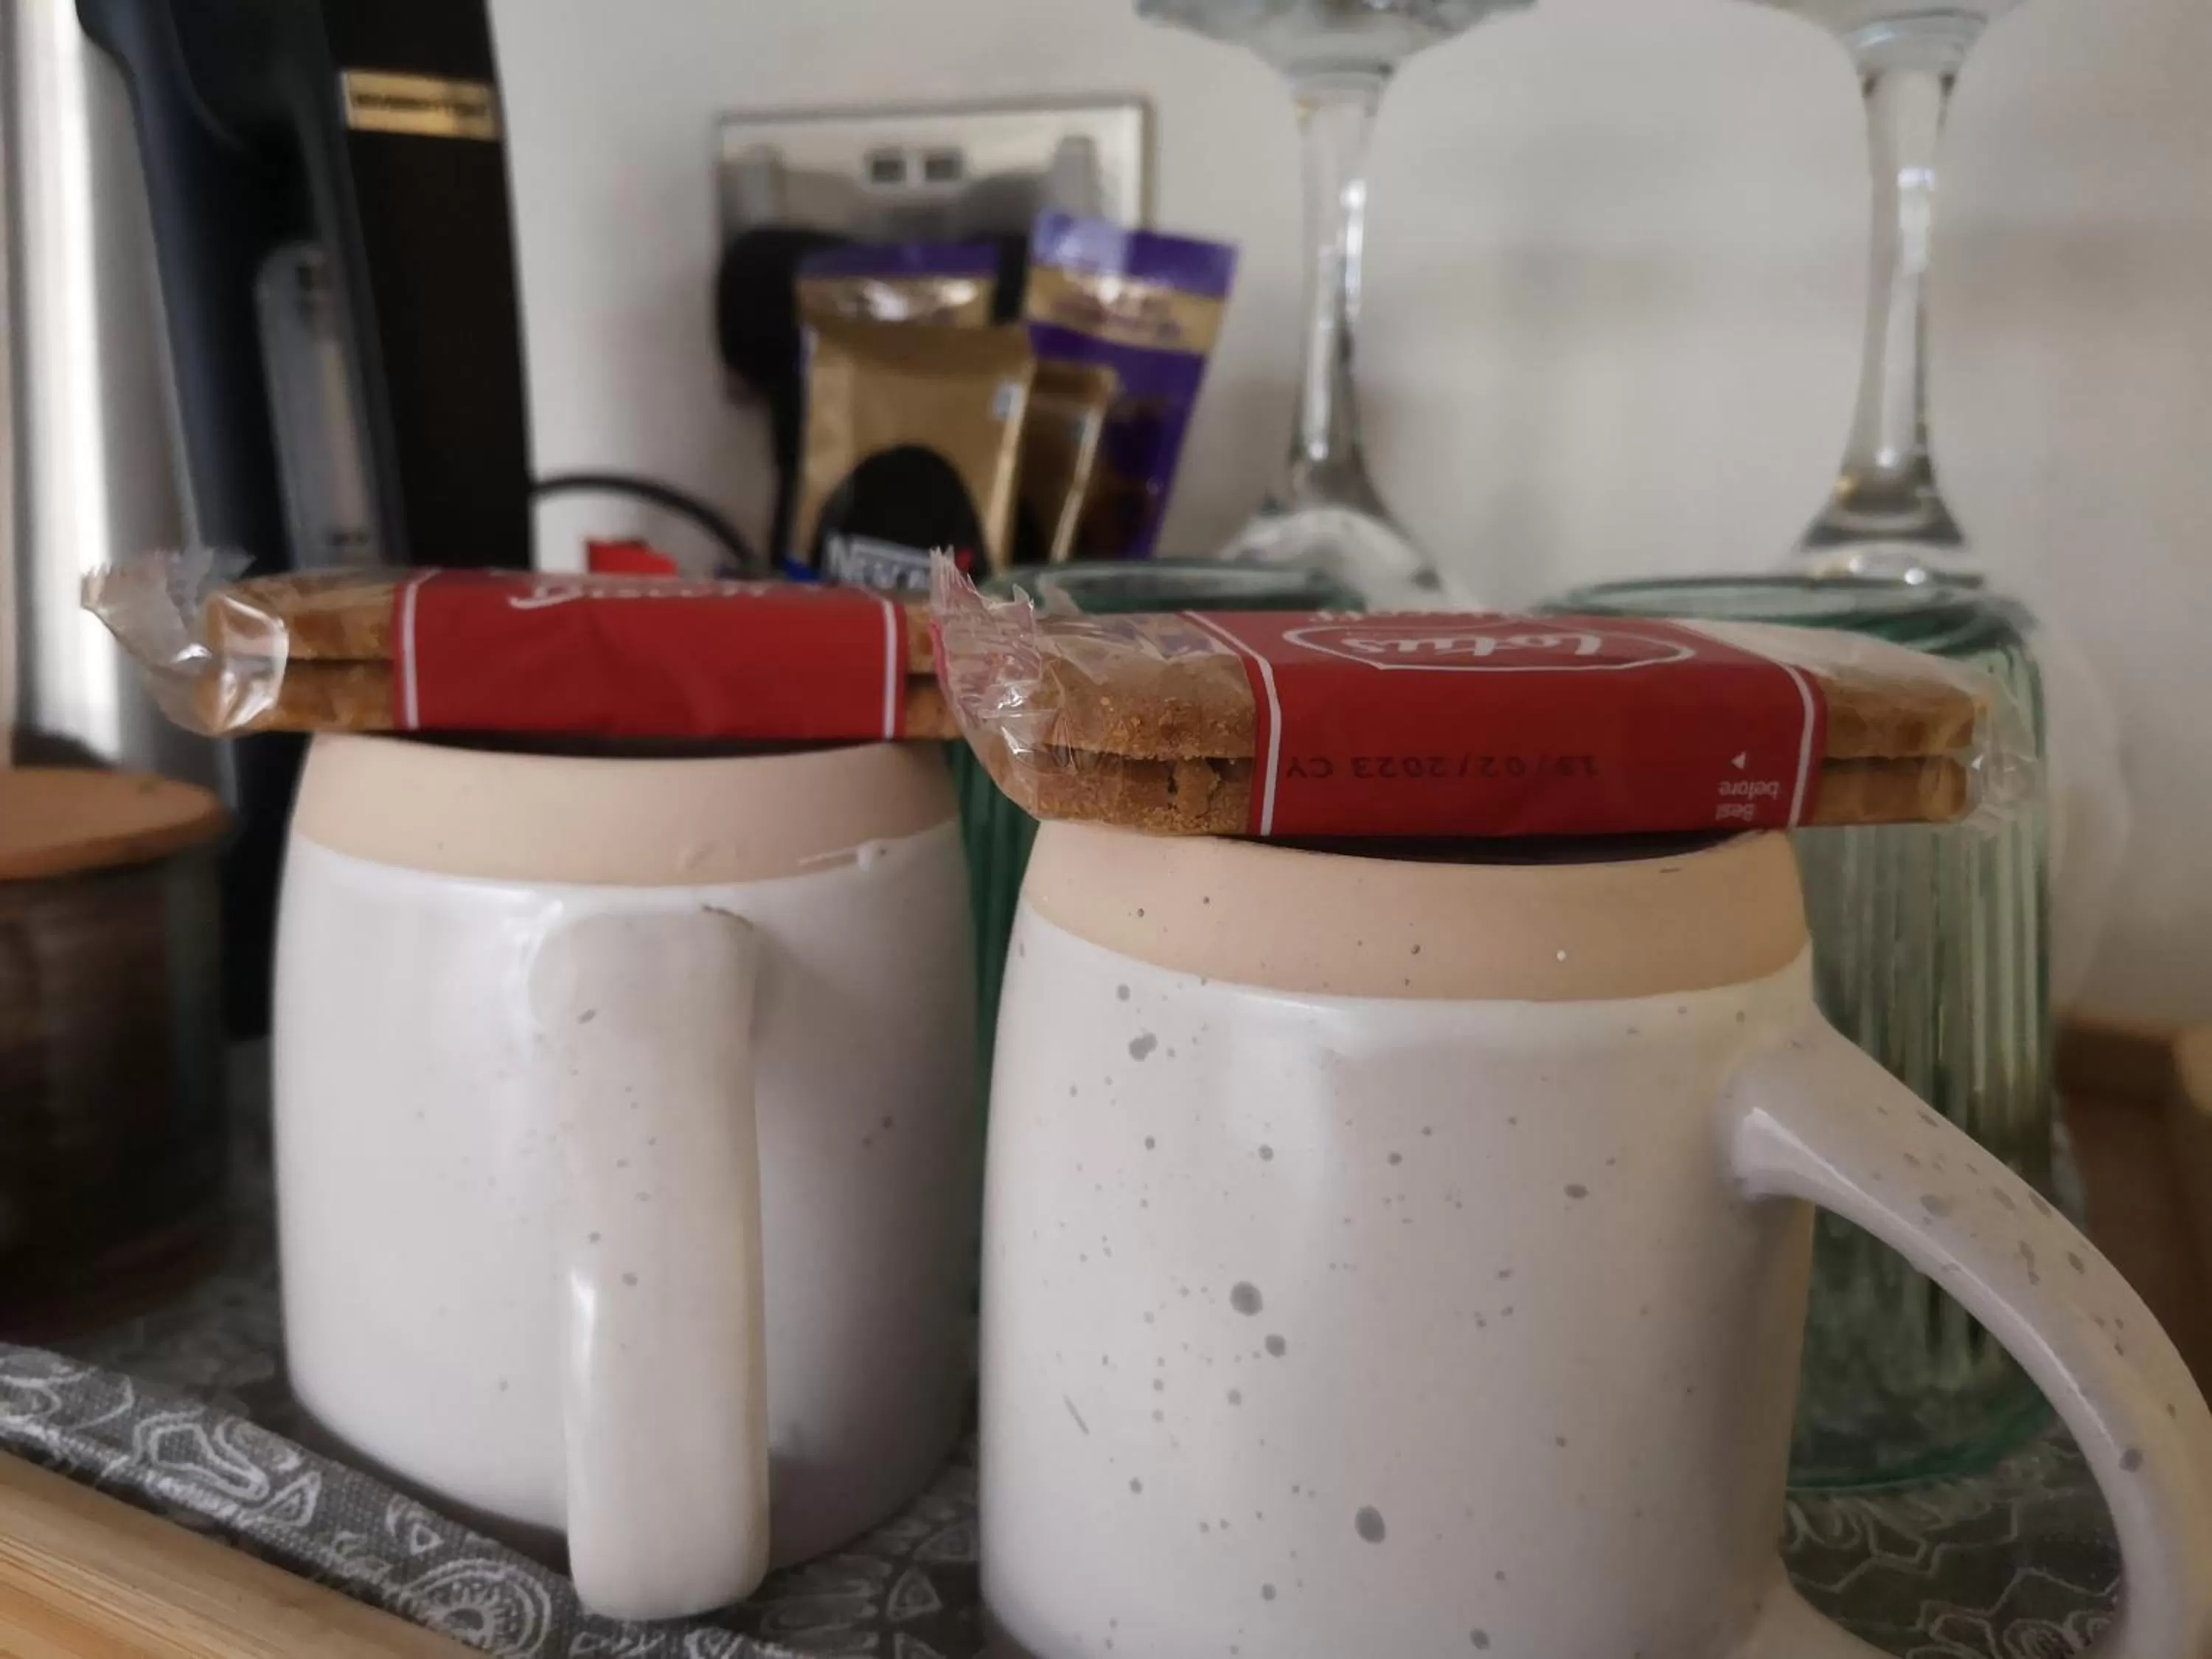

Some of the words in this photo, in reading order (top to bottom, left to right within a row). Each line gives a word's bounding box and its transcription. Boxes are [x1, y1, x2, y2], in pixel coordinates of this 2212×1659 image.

[1340, 631, 1601, 657] Lotus
[1287, 756, 1335, 779] CY
[1717, 779, 1780, 801] before
